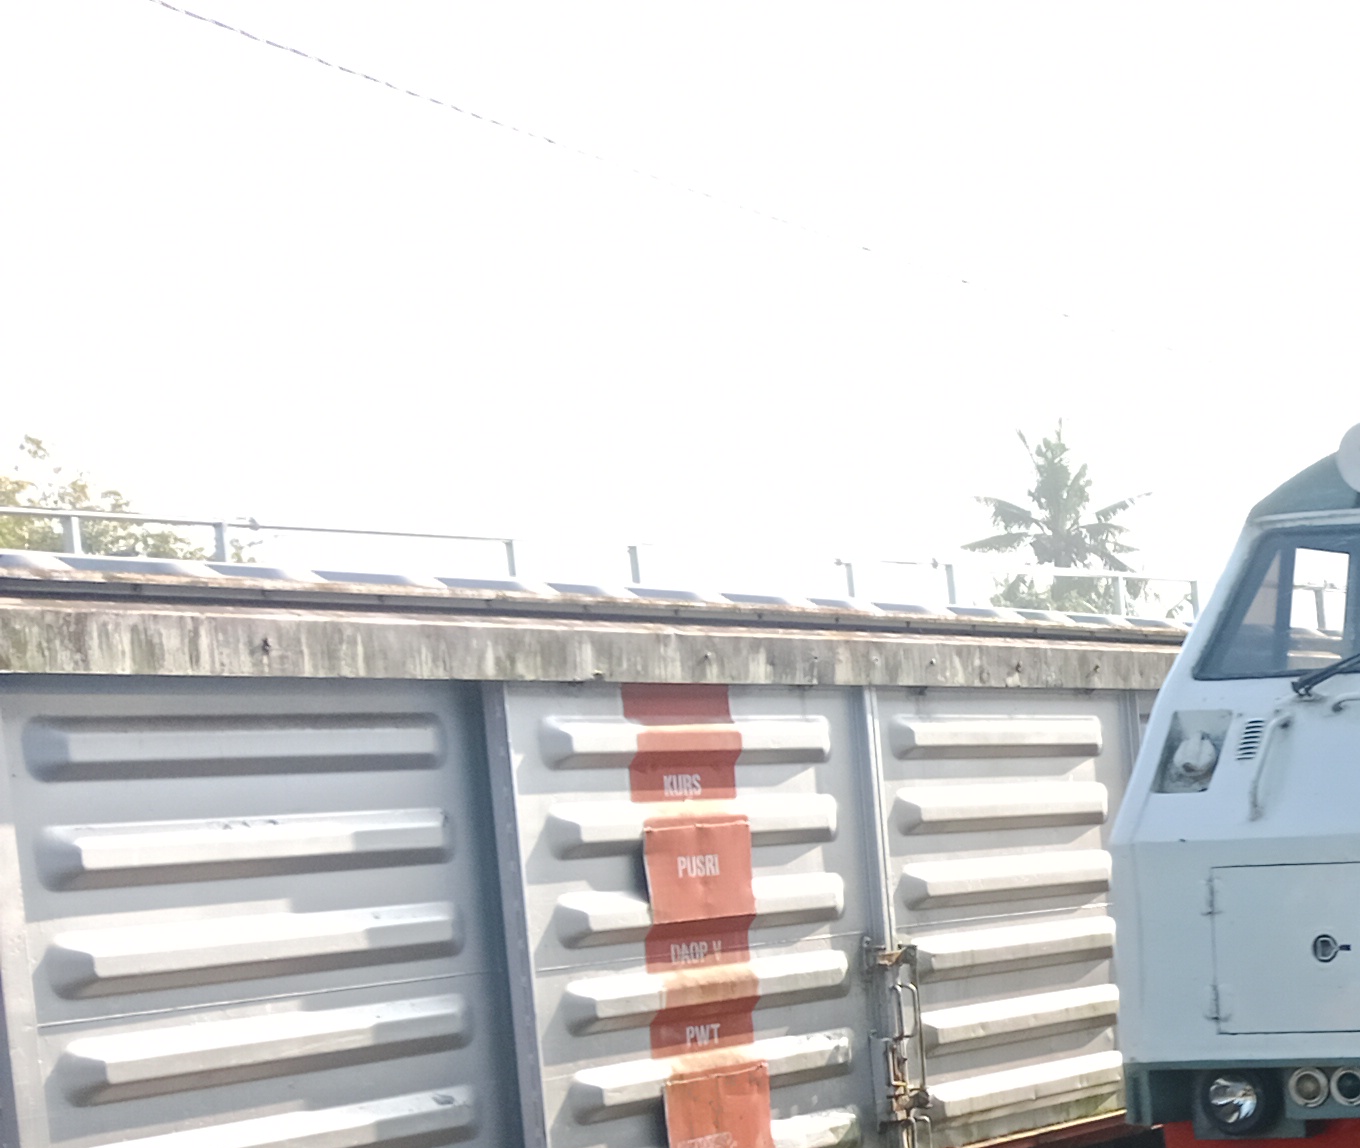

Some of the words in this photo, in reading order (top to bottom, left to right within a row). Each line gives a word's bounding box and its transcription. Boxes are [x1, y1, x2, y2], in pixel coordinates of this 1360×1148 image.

[663, 773, 702, 797] KURS
[677, 854, 720, 878] PUSRI
[670, 941, 708, 965] DAOP
[686, 1023, 720, 1048] PWT
